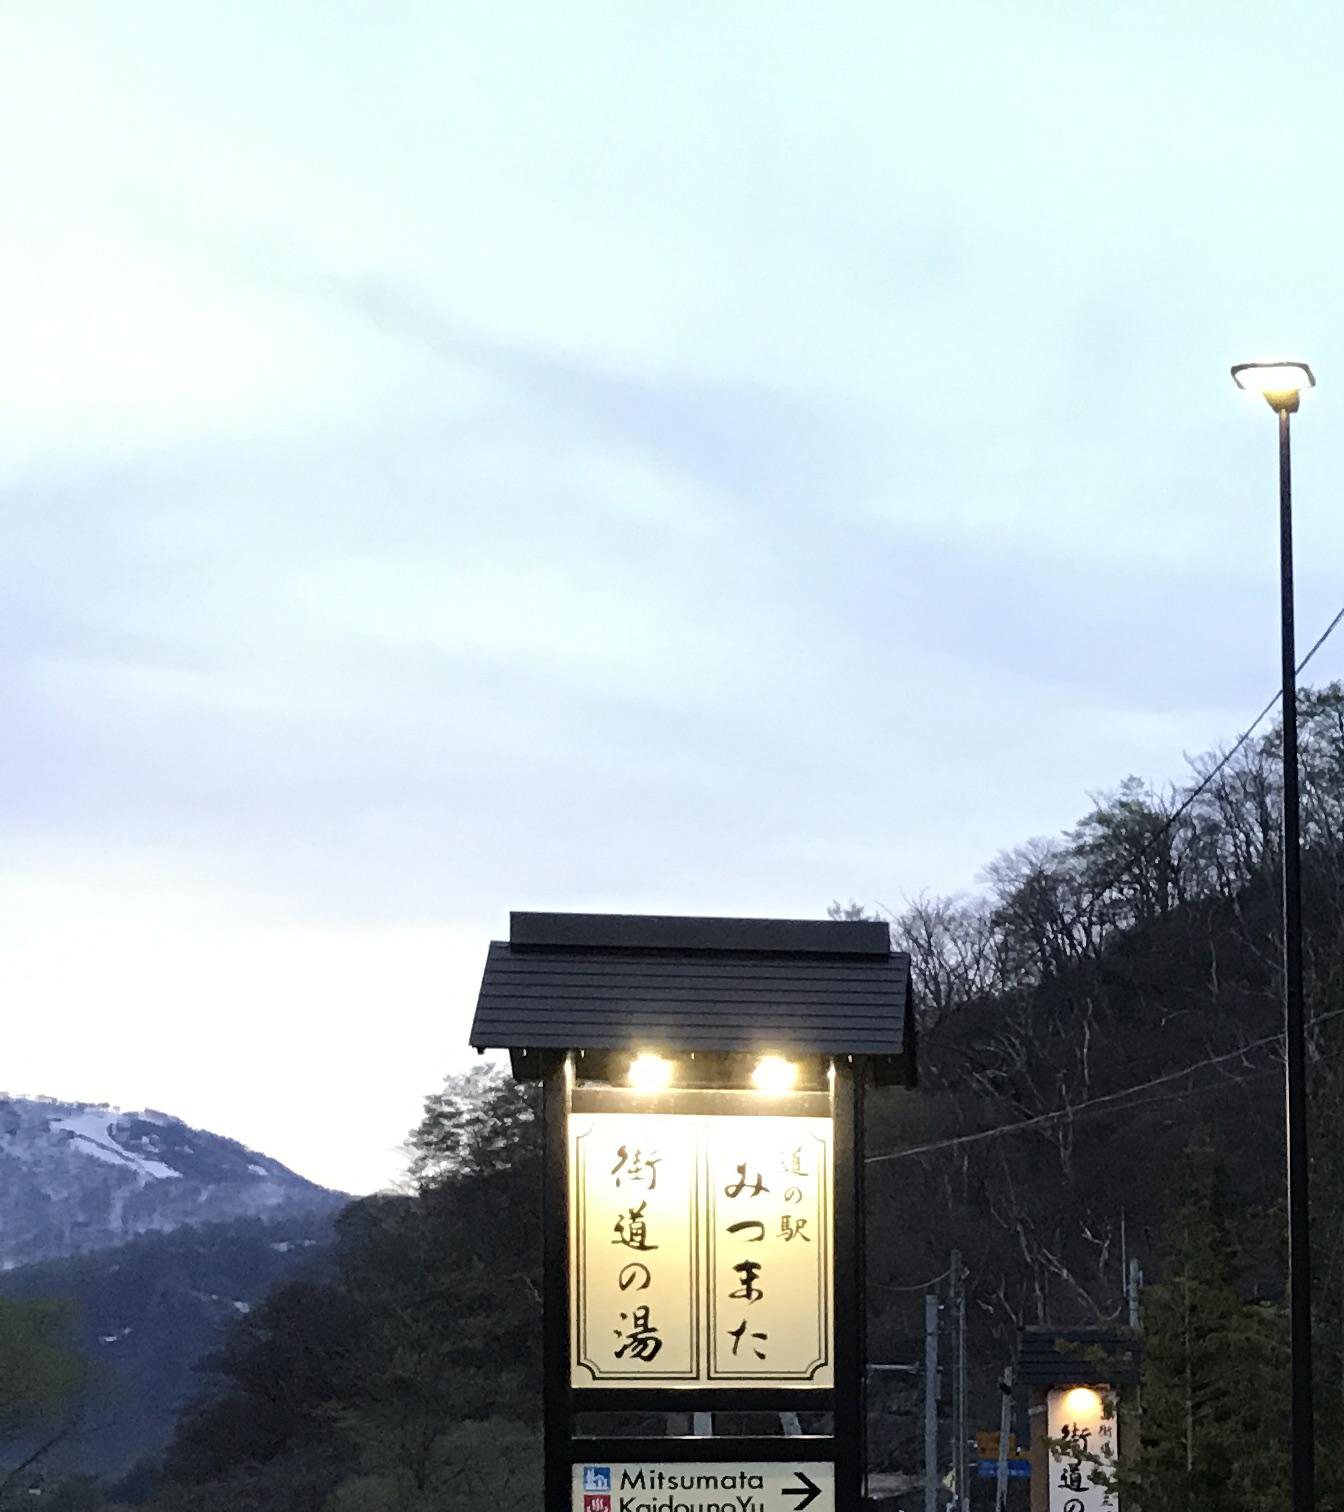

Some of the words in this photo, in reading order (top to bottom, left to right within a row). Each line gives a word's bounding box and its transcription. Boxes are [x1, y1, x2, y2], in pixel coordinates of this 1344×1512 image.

[610, 1144, 664, 1362] 街道の湯
[724, 1162, 770, 1360] みつまた
[776, 1145, 811, 1242] 道の駅
[620, 1469, 764, 1490] Mitsumata
